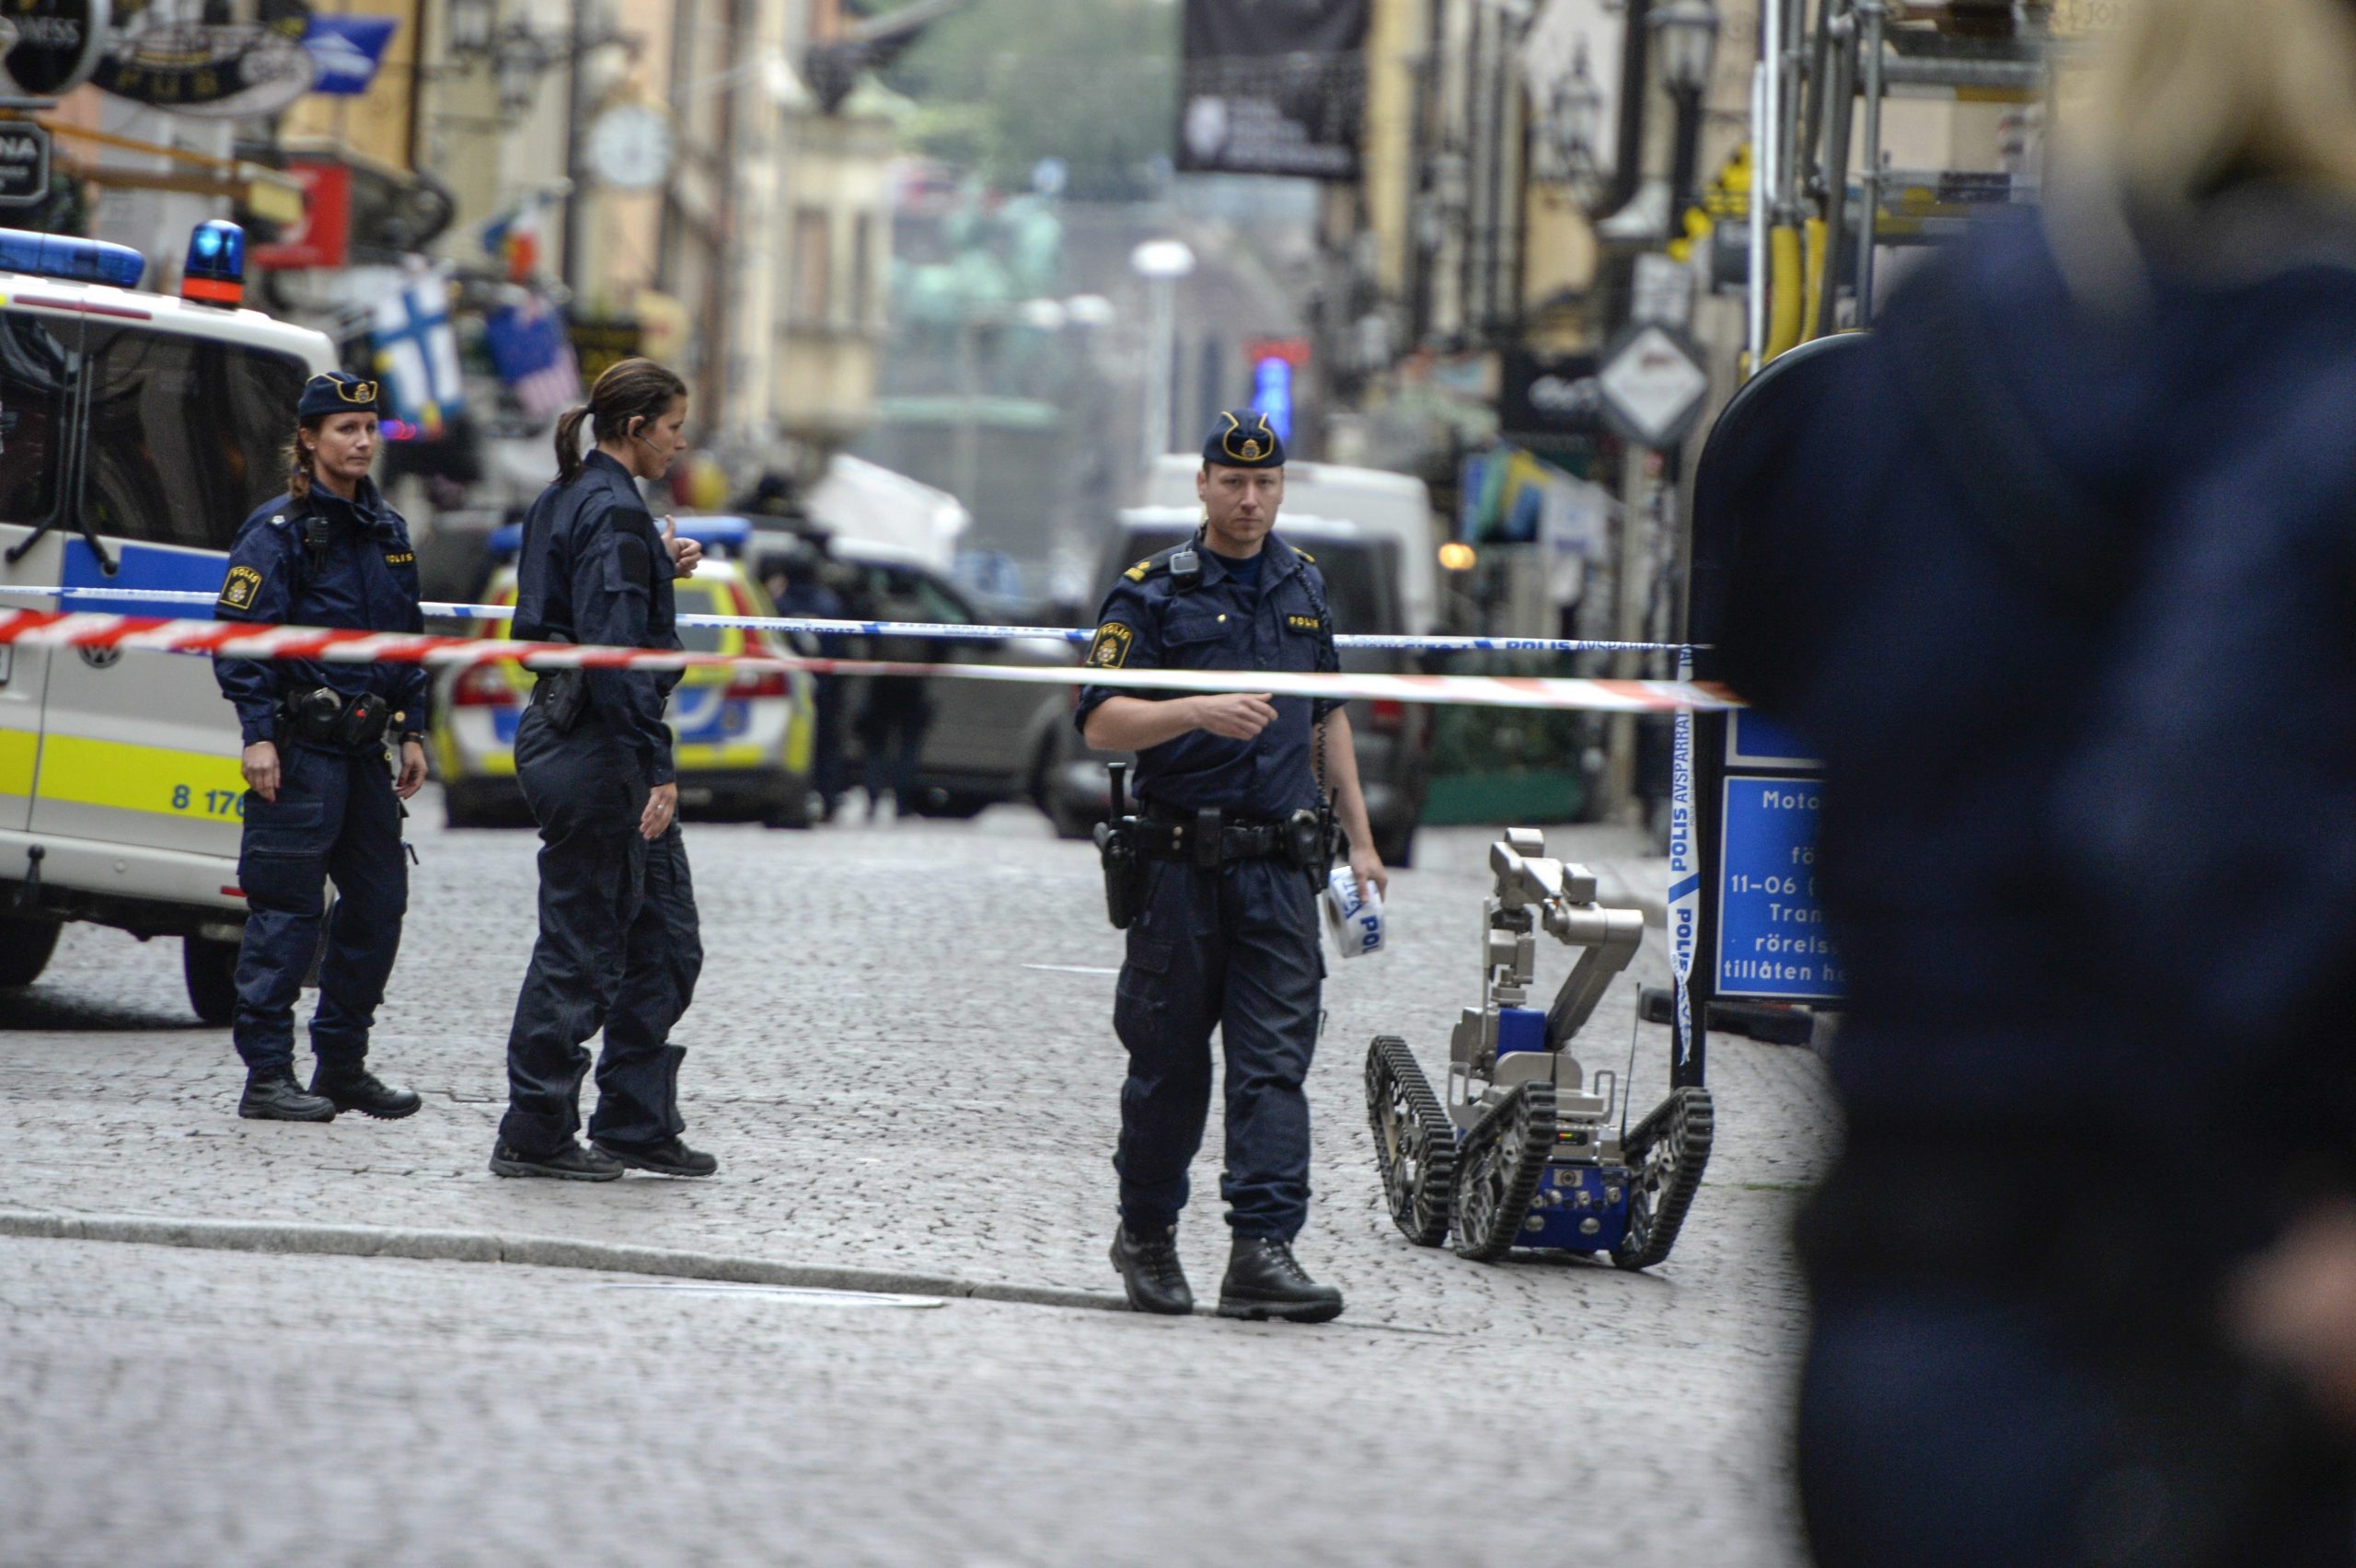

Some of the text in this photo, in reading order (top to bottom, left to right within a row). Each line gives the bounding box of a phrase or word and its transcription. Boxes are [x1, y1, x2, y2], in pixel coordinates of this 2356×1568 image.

[387, 553, 413, 562] POLIS
[232, 568, 260, 582] POLIS
[1288, 616, 1319, 628] POLIS
[1102, 625, 1131, 640] POLIS
[172, 784, 190, 810] 8
[1762, 790, 1820, 810] Moto
[1671, 808, 1688, 871] POLIS
[1791, 847, 1815, 864] fö
[1731, 875, 1796, 894] 11-06
[1769, 903, 1821, 922] Tran
[1755, 933, 1839, 953] rörels
[1724, 959, 1812, 981] tillåten
